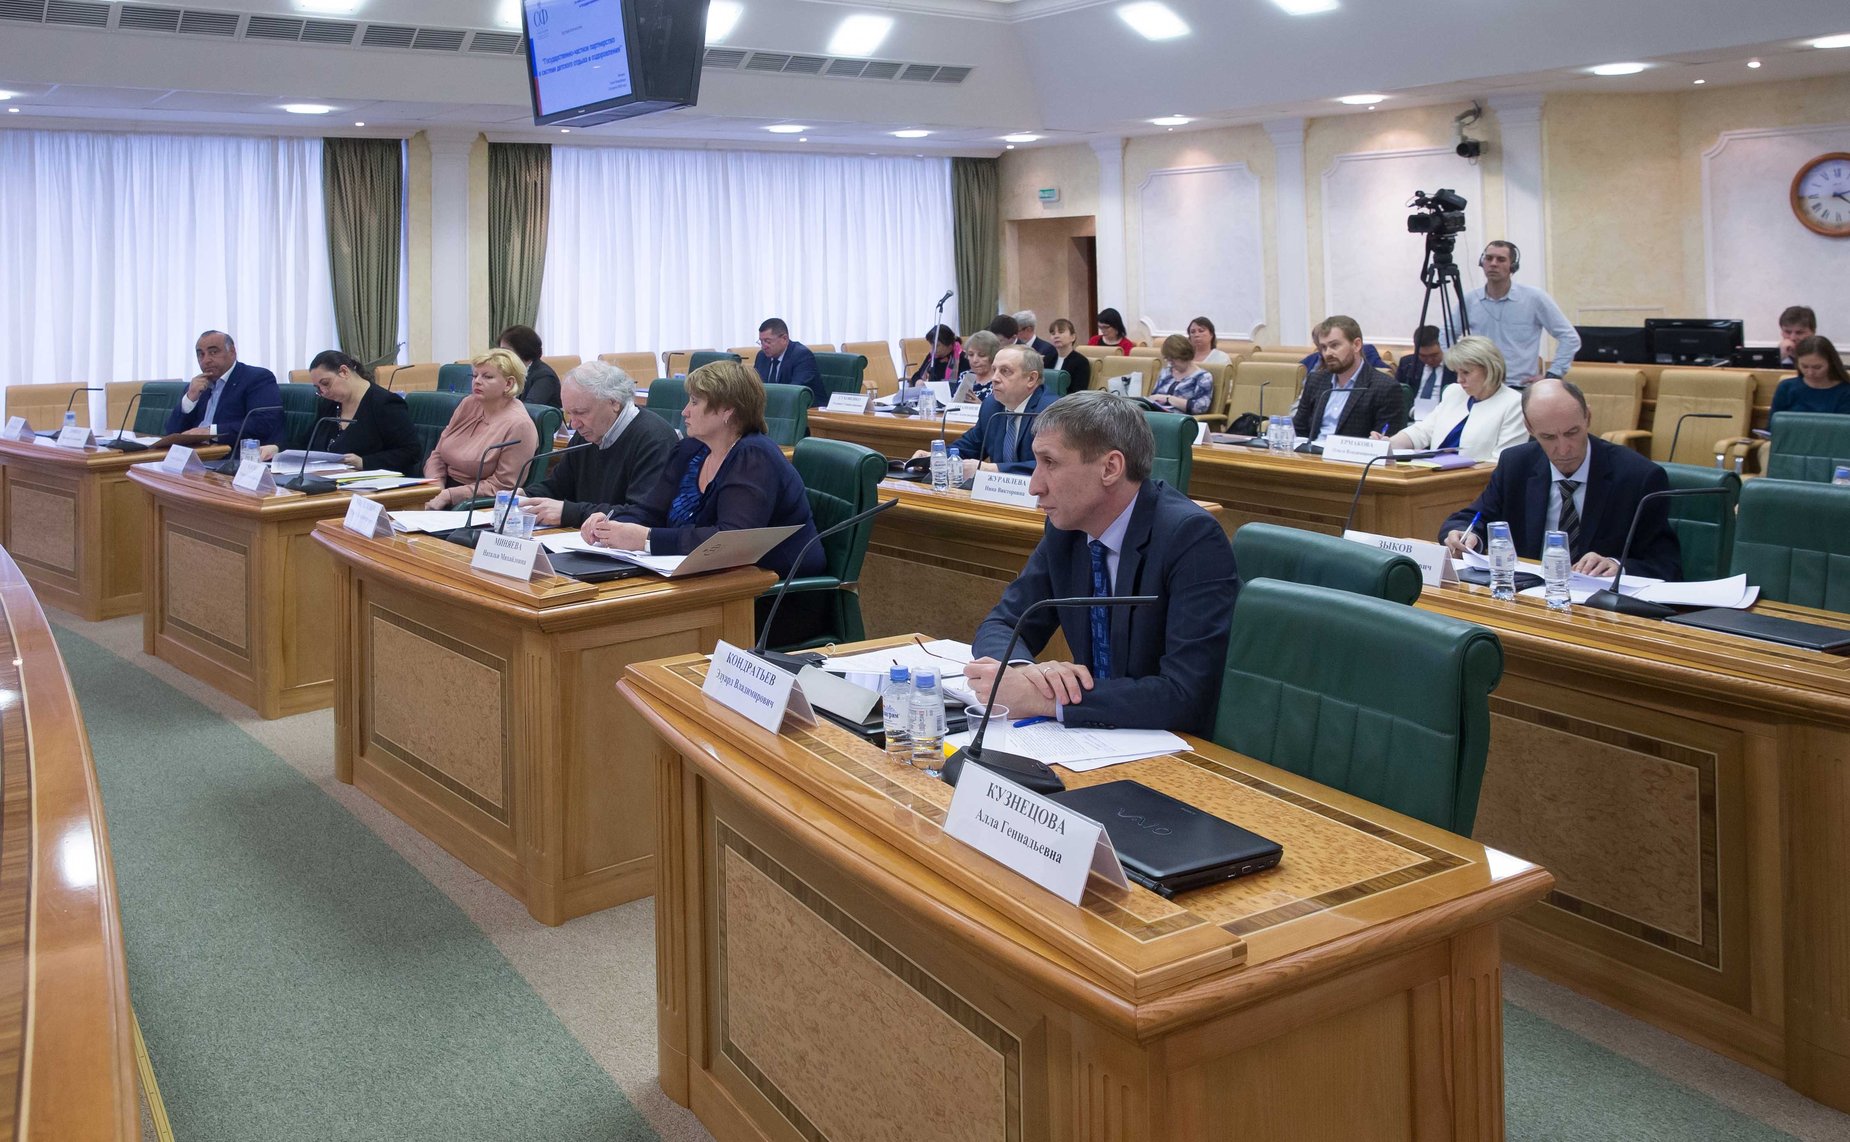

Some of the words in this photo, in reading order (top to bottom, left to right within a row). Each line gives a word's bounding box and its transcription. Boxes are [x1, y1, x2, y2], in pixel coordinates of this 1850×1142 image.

[988, 475, 1027, 486] ЖУРАВЛЕВА
[1379, 540, 1413, 554] ЗЫКОВ
[726, 652, 777, 686] КОНДРАТЬЕВ
[715, 668, 734, 687] Эдуард
[733, 678, 775, 709] Владимирович
[986, 782, 1066, 836] КУЗНЕЦОВА
[1117, 807, 1173, 836] VAIO
[975, 808, 999, 830] Алла
[1000, 820, 1063, 864] Геннадьевна
